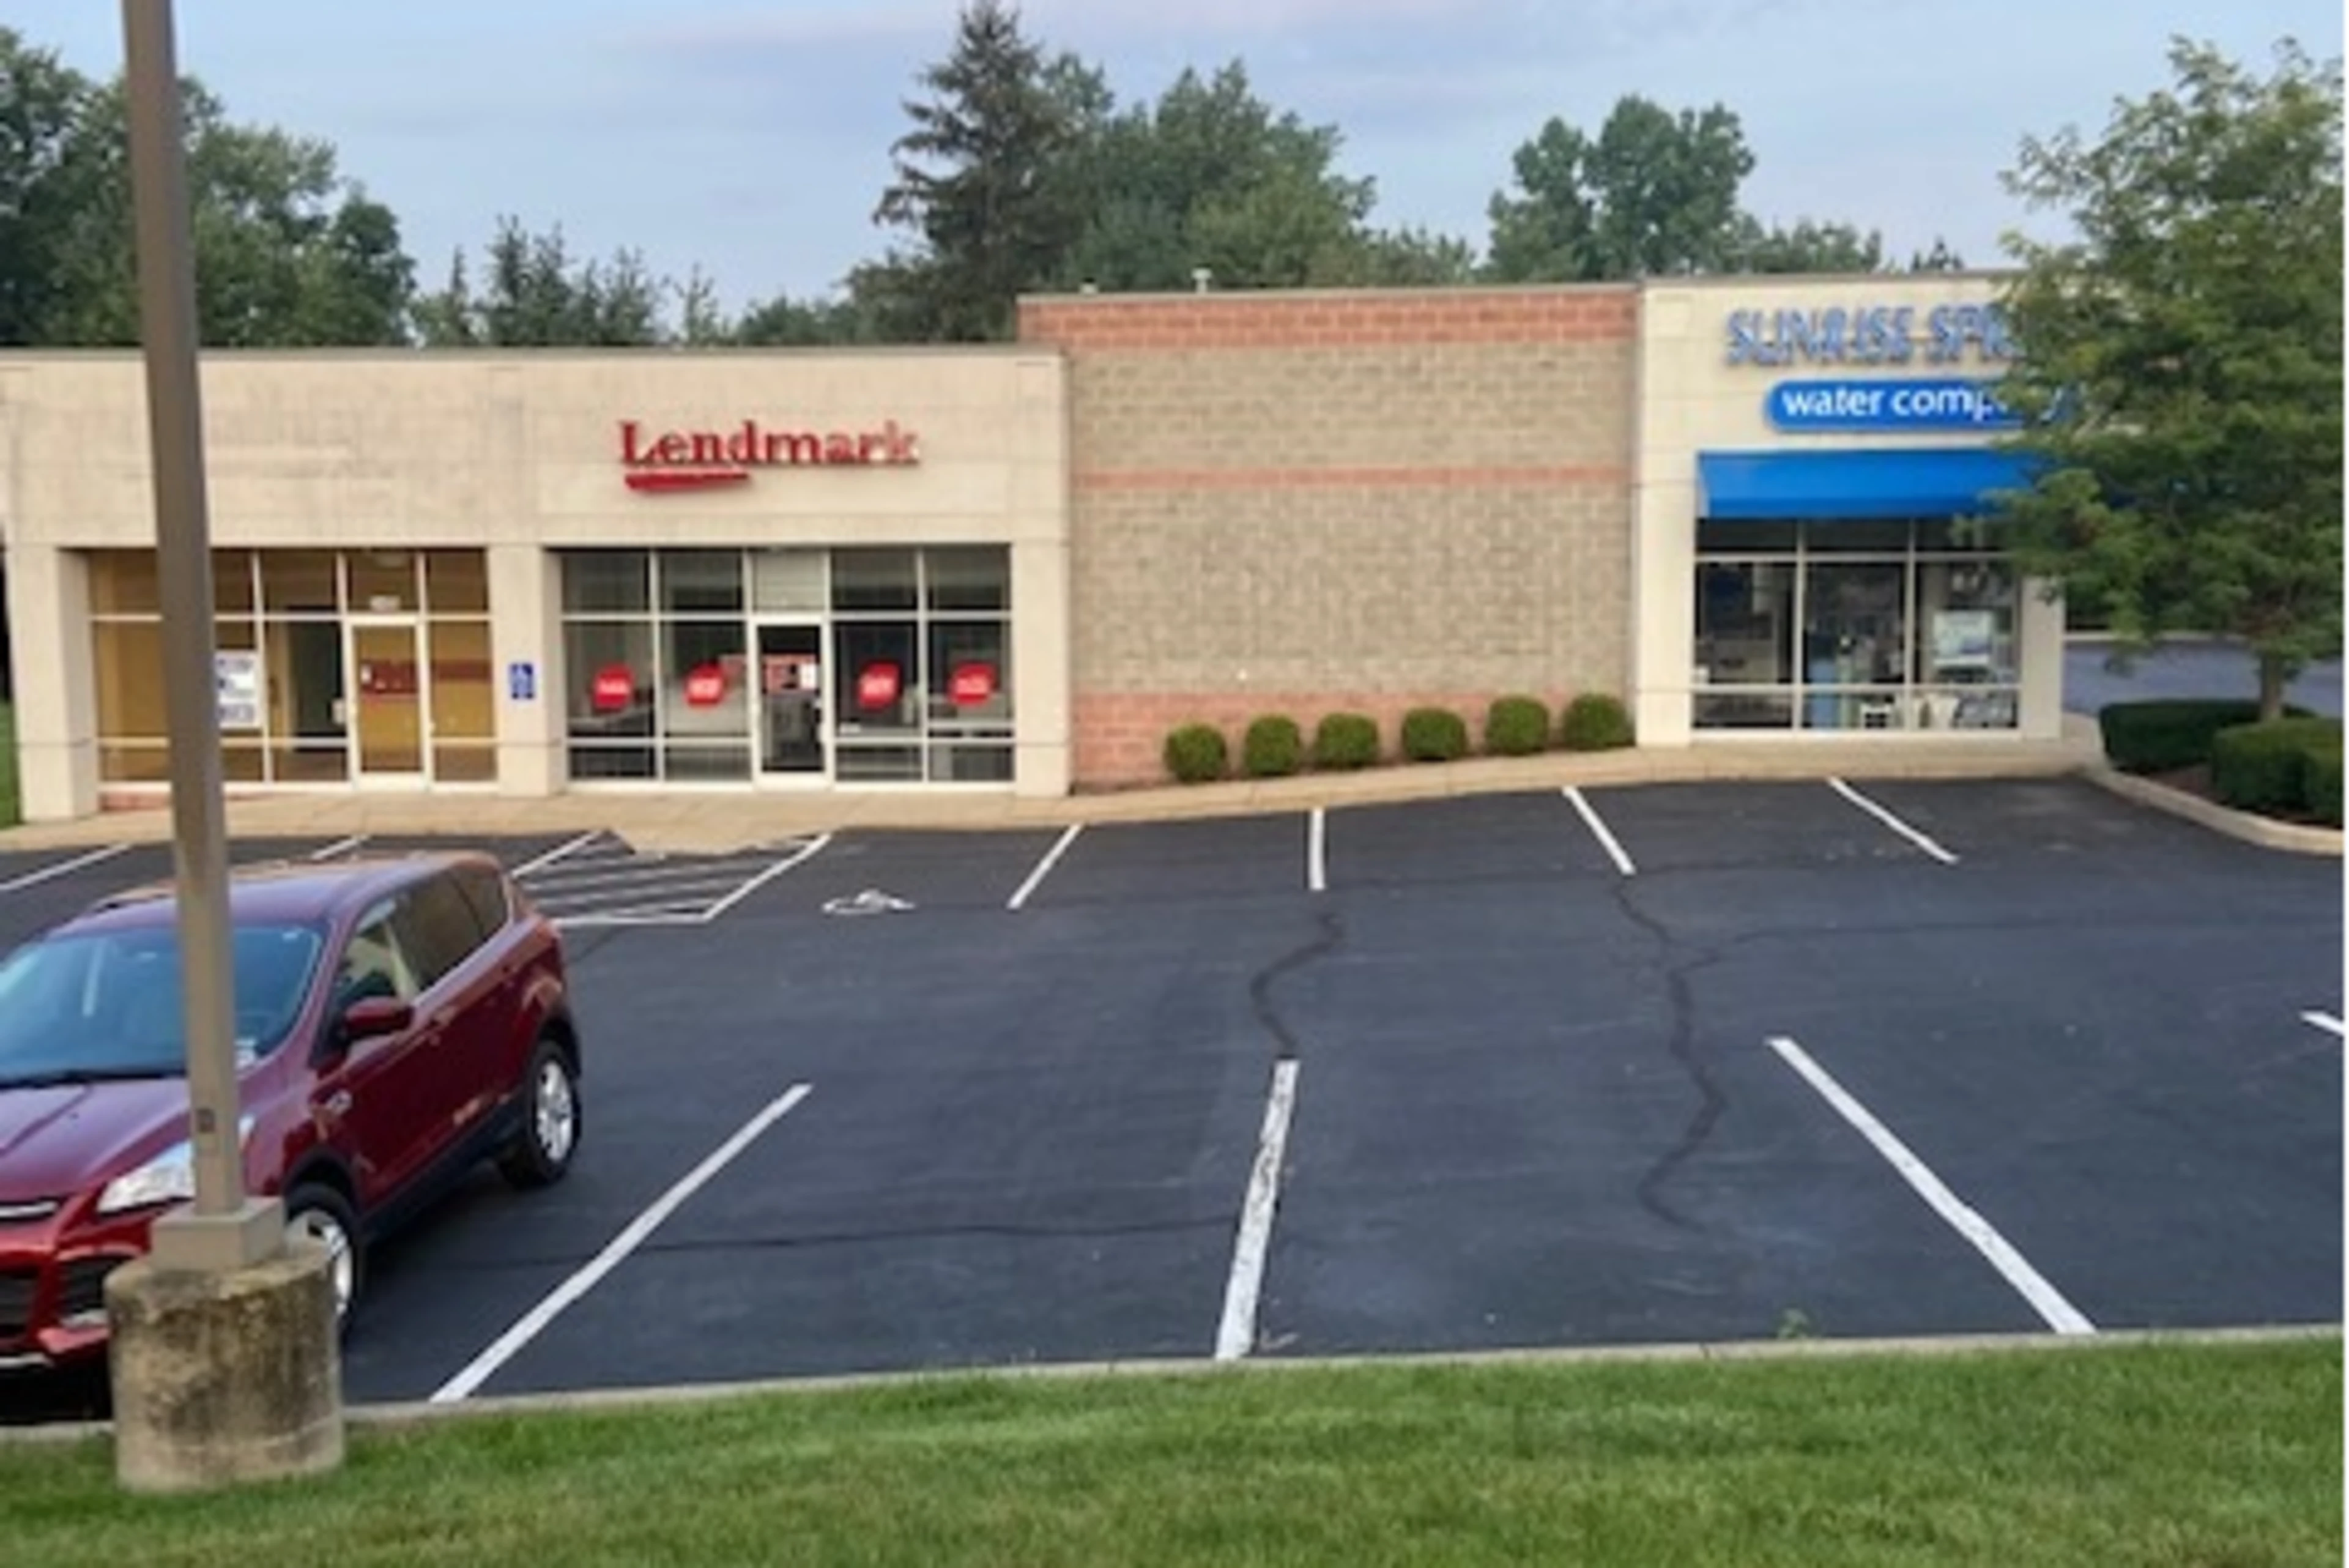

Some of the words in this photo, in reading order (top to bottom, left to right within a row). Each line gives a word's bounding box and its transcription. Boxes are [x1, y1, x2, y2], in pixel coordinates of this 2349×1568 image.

[1726, 307, 1915, 365] SUNRISE
[1781, 387, 1883, 417] water
[618, 419, 920, 466] Lendmark
